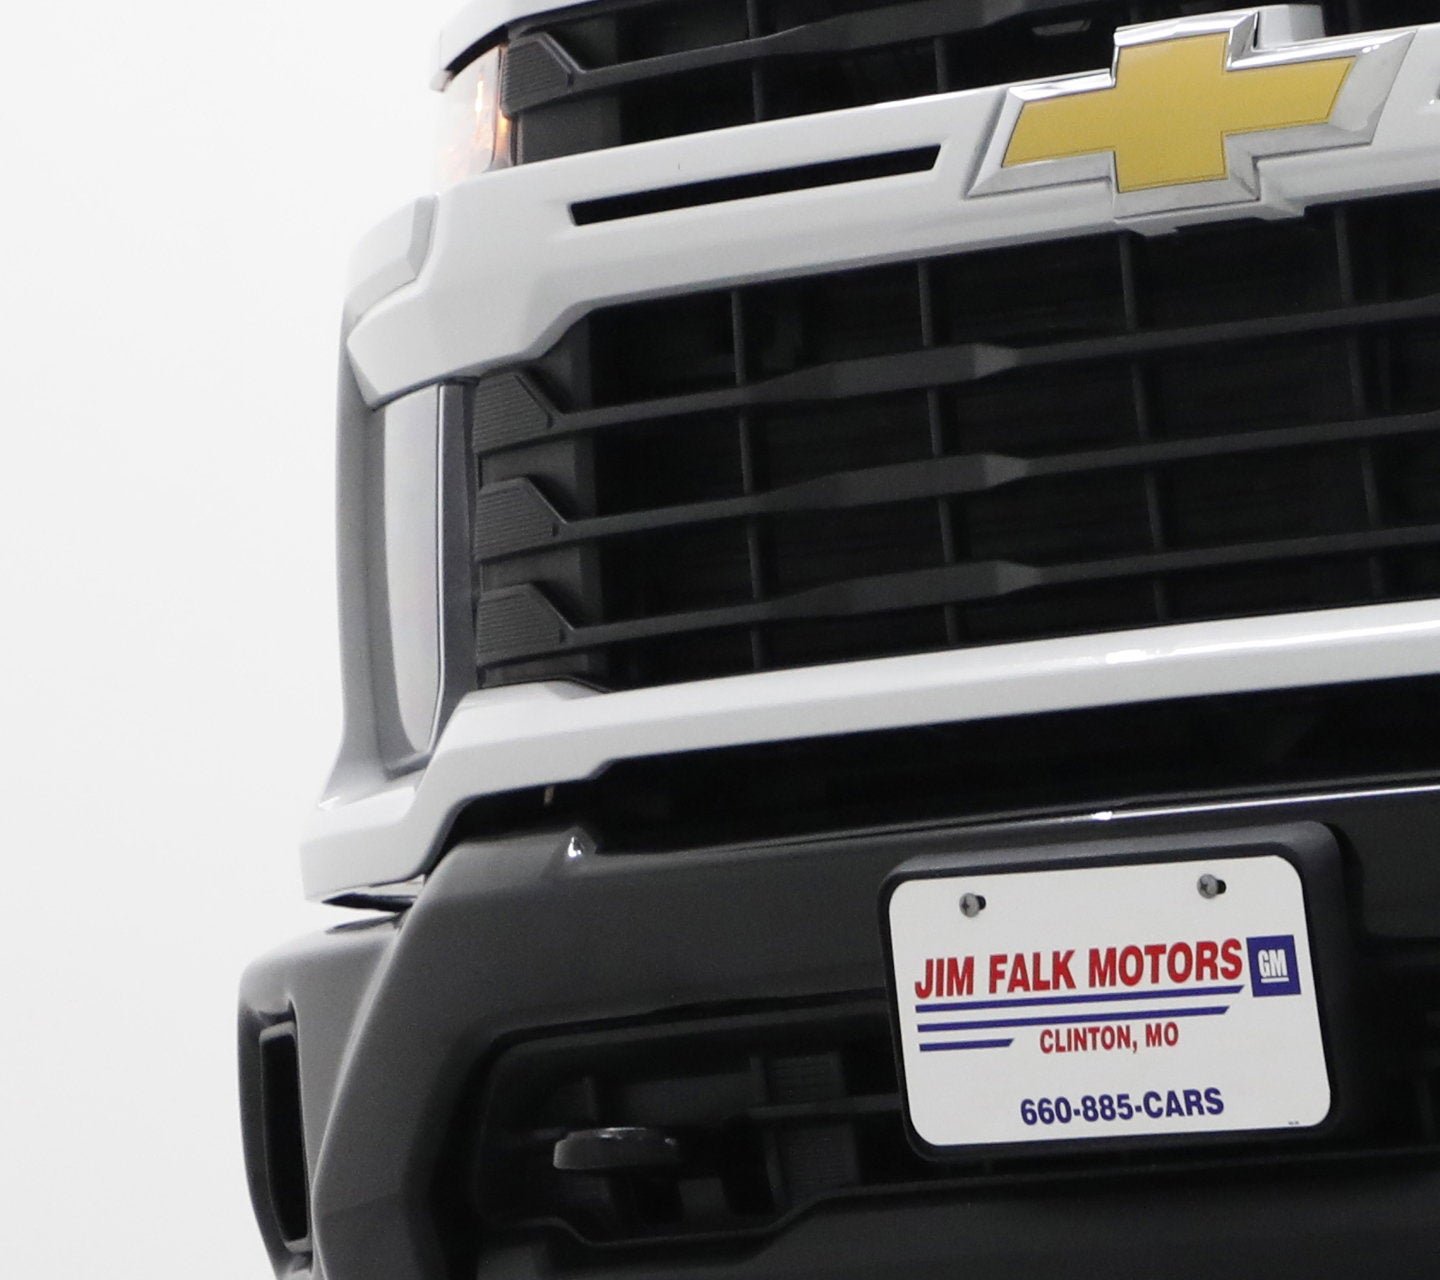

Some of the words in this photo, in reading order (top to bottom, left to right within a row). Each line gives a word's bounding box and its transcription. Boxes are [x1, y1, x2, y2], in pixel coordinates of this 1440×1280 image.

[914, 955, 976, 1000] JIM
[988, 949, 1077, 995] FALK
[1088, 937, 1244, 989] MOTORS
[1257, 948, 1288, 978] GM
[1039, 1025, 1139, 1055] CLINTON,
[1145, 1021, 1180, 1048] MO
[1021, 1087, 1224, 1126] 660-885-CARS
